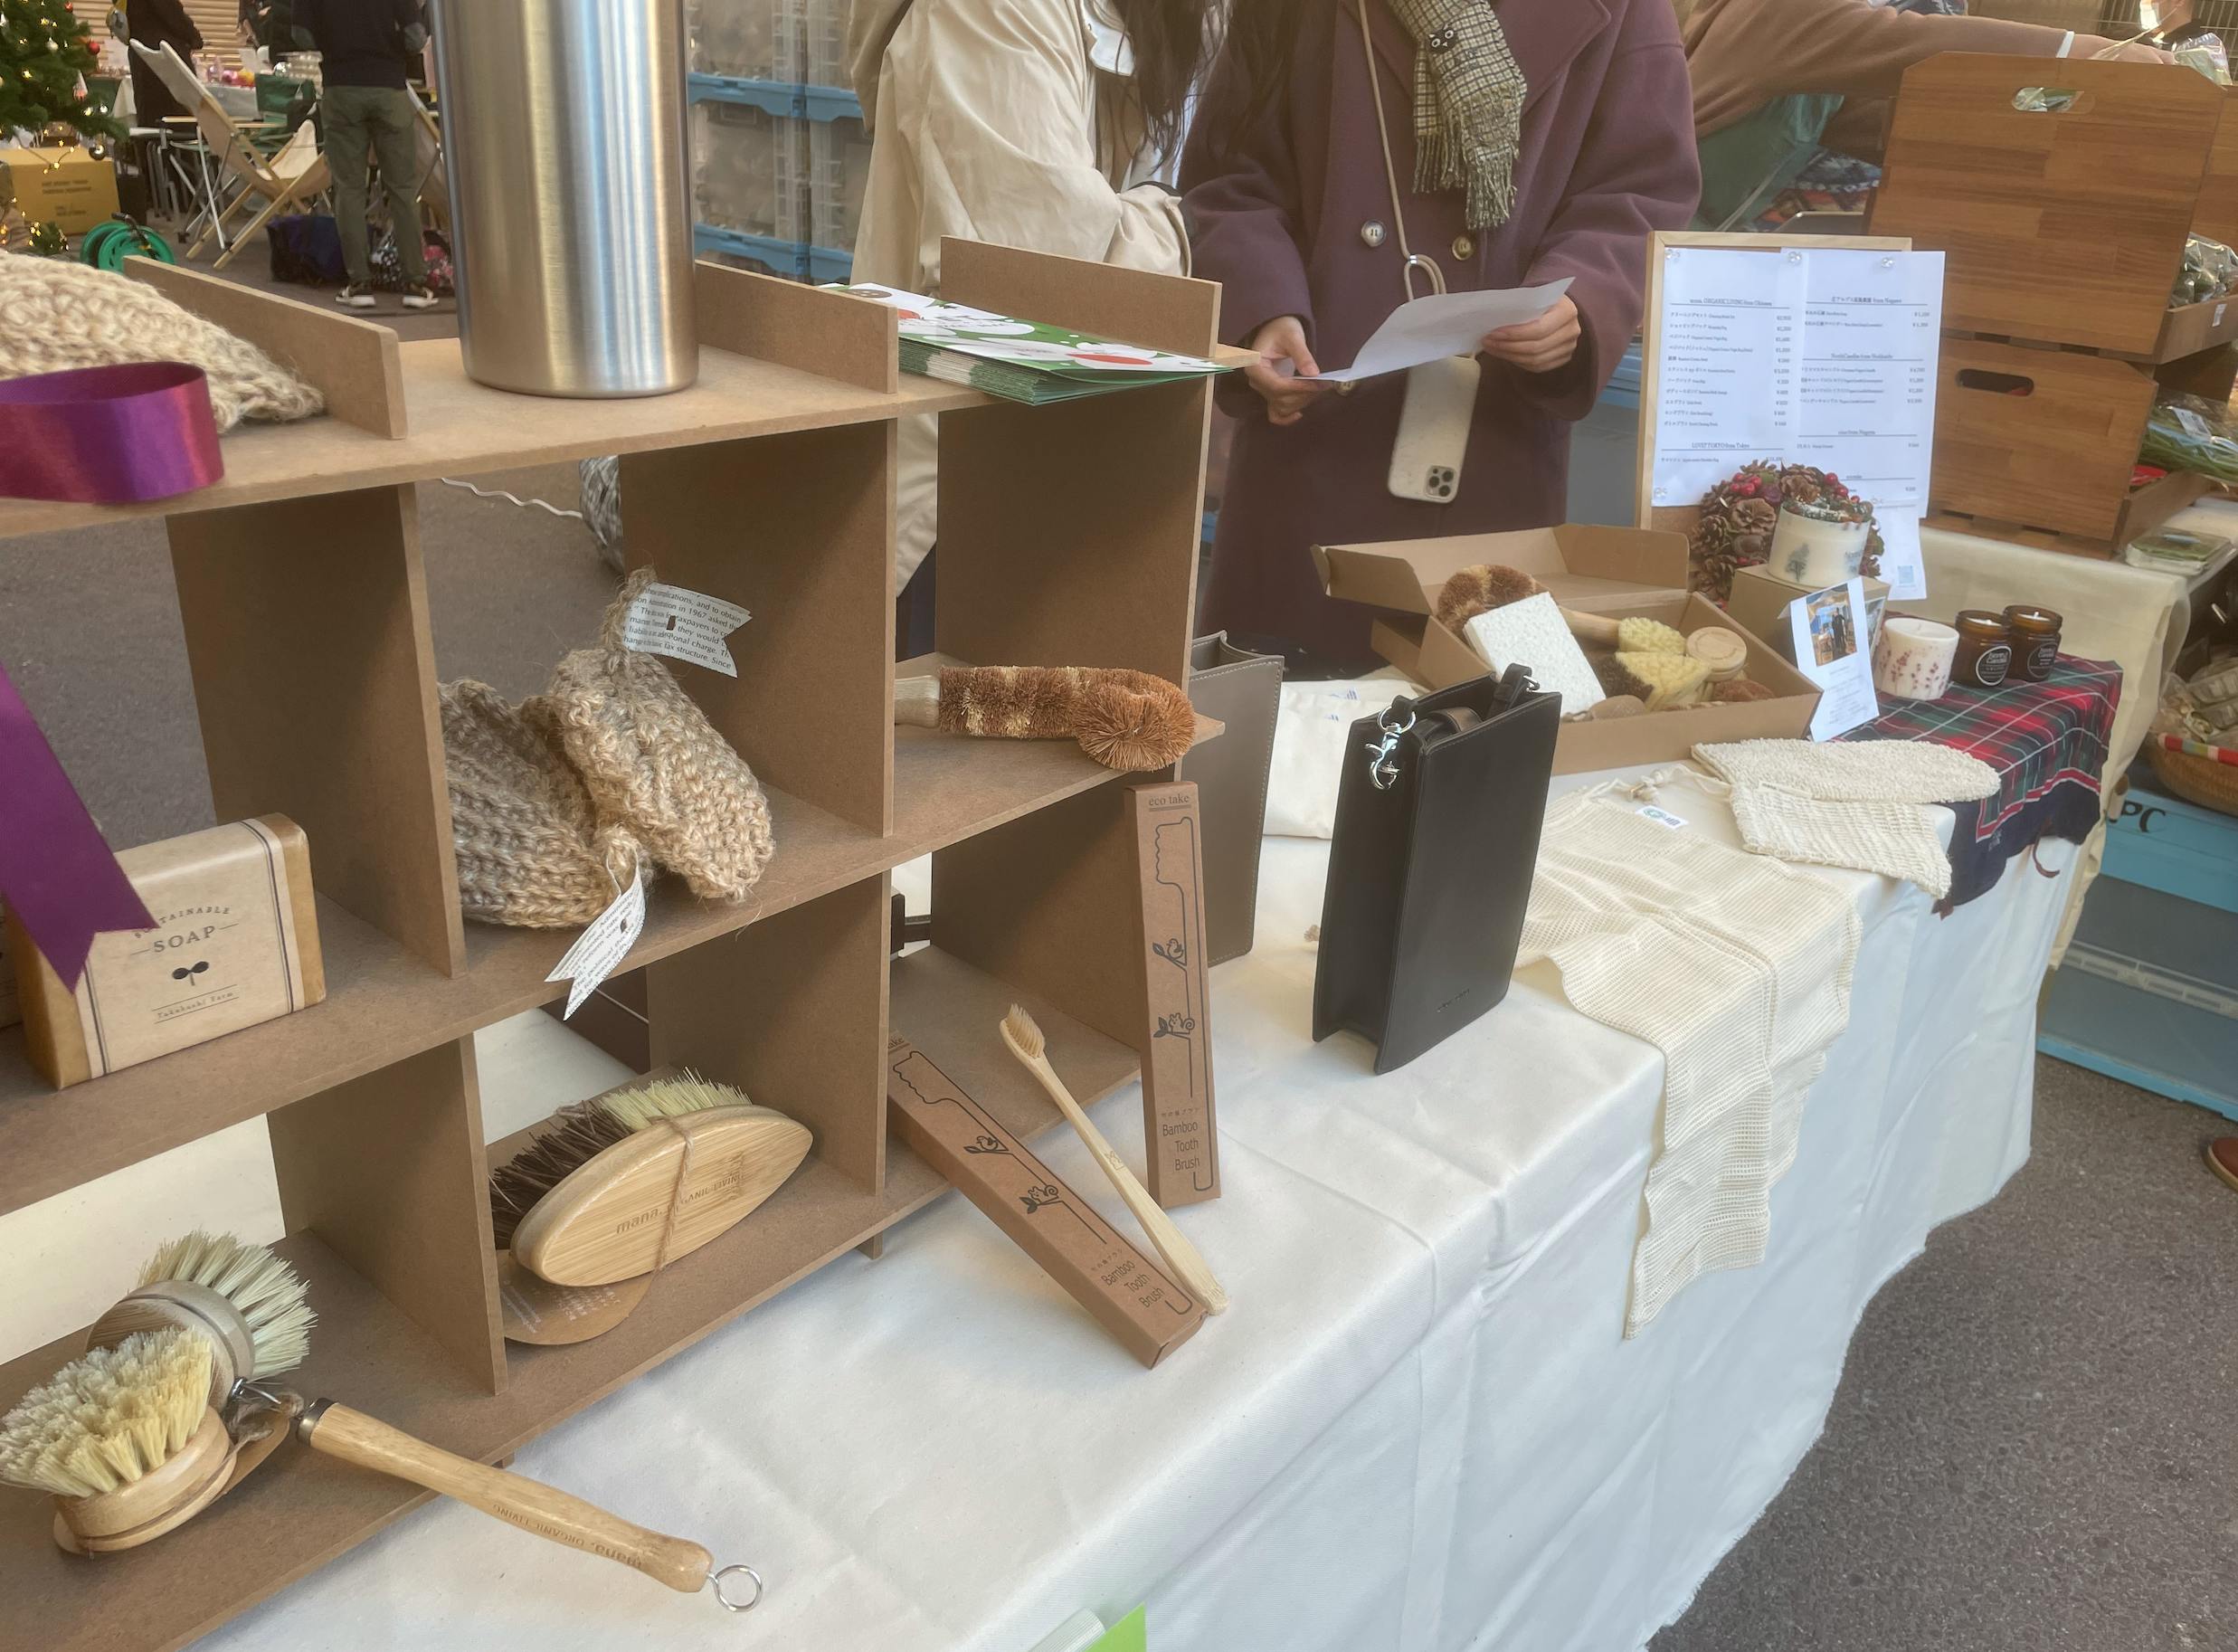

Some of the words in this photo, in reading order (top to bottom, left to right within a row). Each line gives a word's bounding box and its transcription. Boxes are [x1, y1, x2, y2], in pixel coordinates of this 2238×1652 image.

[689, 608, 706, 618] 1967
[708, 616, 728, 627] asked
[721, 611, 742, 622] obtain
[678, 625, 694, 636] they
[697, 632, 719, 644] would
[711, 657, 732, 669] Since
[1149, 796, 1166, 806] eco
[1169, 793, 1190, 804] take
[154, 926, 215, 953] SOAP
[1162, 1121, 1199, 1137] Bamboo
[1174, 1138, 1200, 1153] Tooth
[1175, 1155, 1200, 1172] Brush
[1101, 1260, 1135, 1286] Bamboo
[1124, 1273, 1151, 1293] Tooth
[1138, 1286, 1165, 1308] Brush
